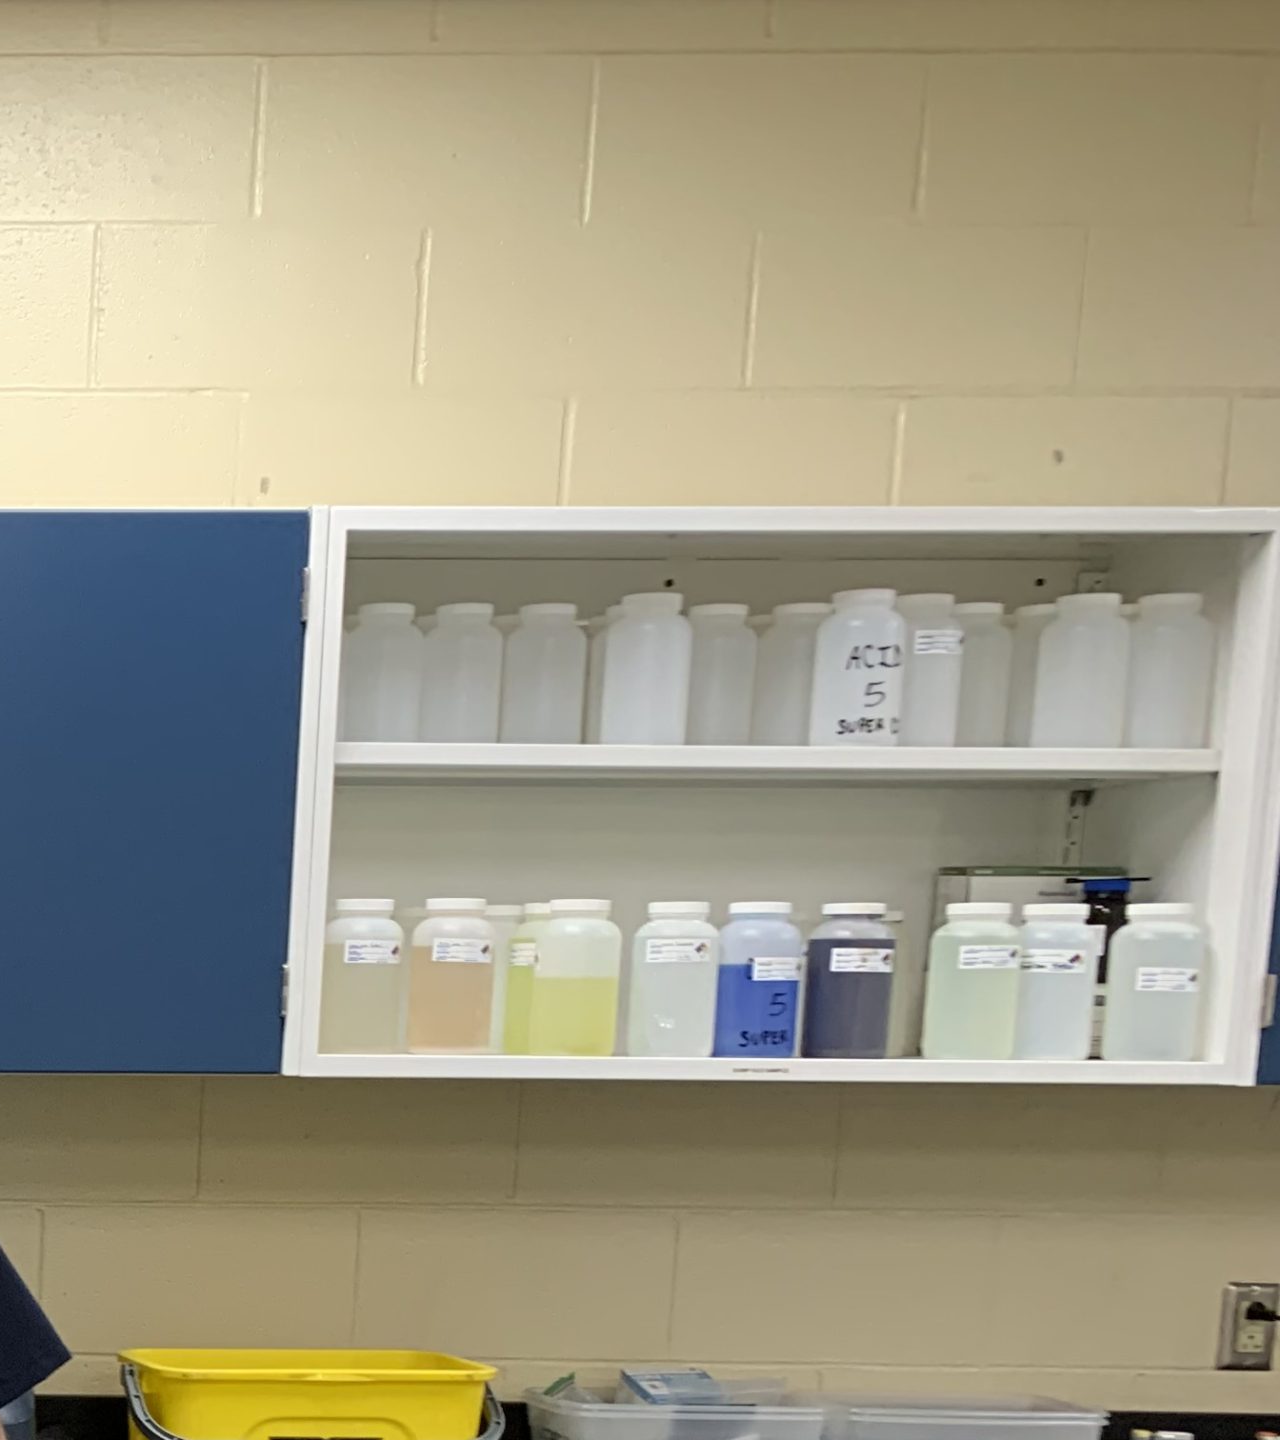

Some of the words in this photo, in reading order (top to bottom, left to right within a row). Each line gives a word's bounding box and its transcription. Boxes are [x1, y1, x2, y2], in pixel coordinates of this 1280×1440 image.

[845, 644, 903, 670] ACID
[863, 681, 887, 707] 5
[768, 992, 788, 1017] 5
[738, 1030, 788, 1048] SUPER
